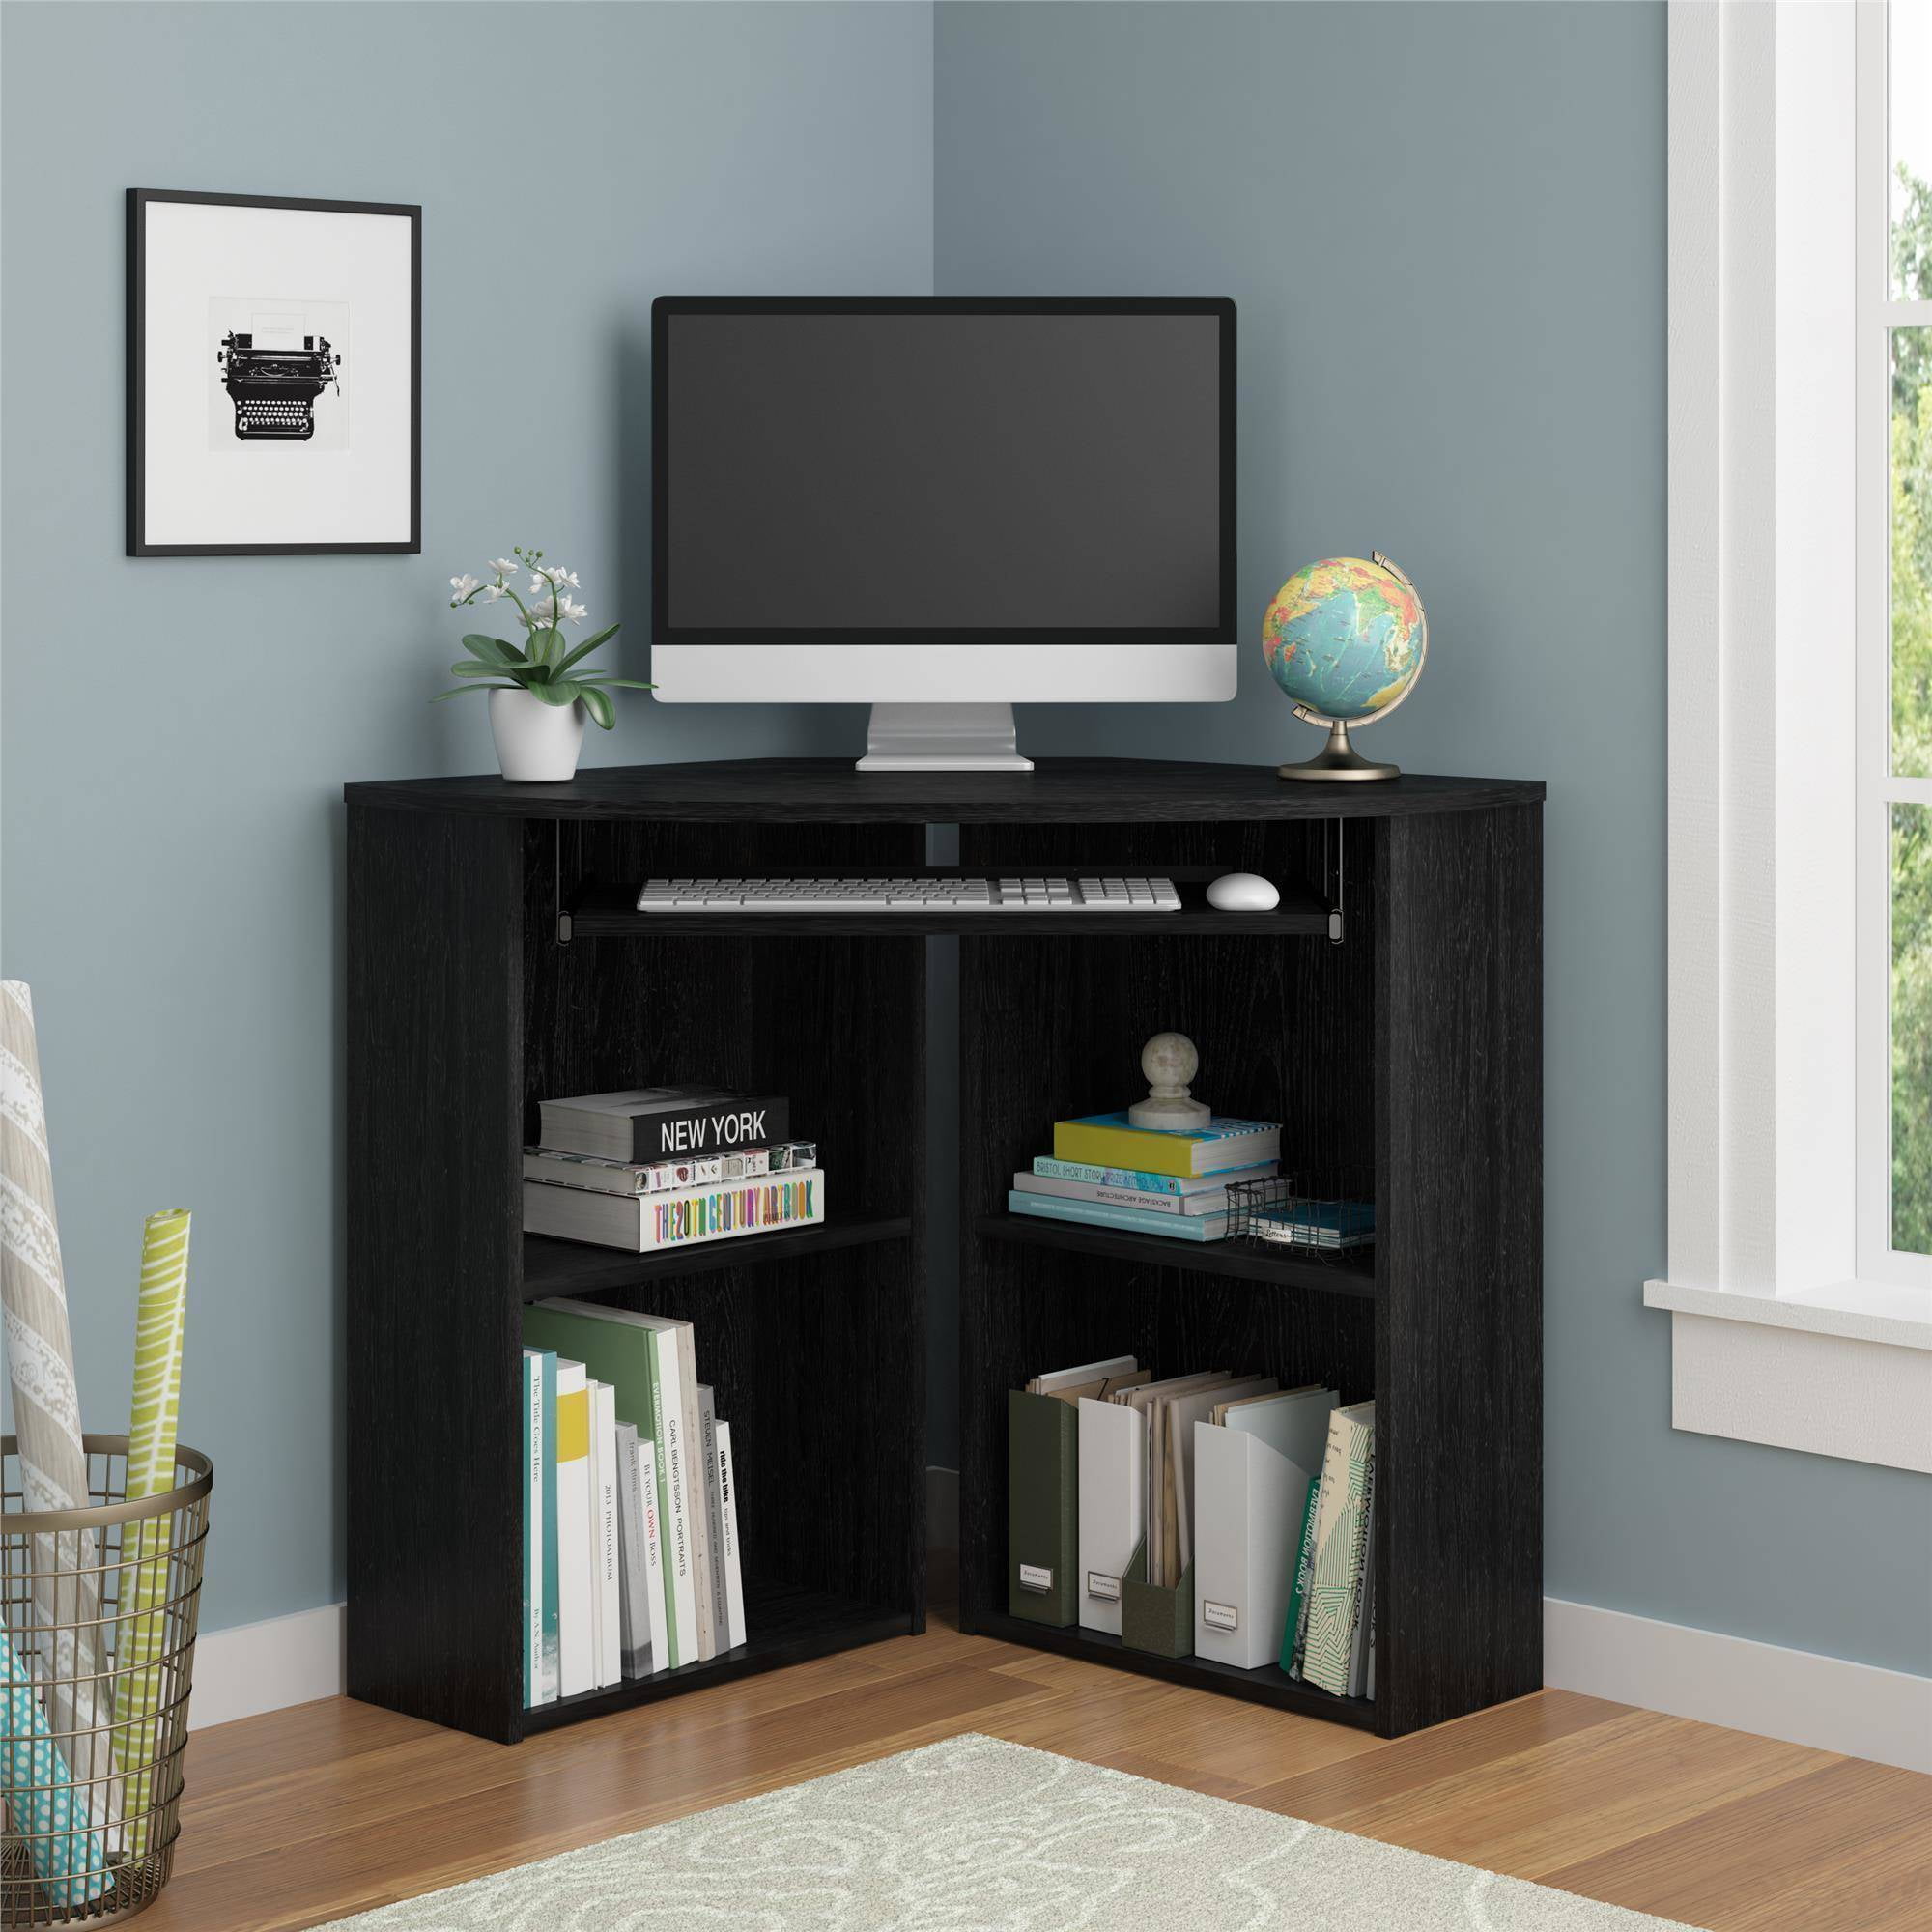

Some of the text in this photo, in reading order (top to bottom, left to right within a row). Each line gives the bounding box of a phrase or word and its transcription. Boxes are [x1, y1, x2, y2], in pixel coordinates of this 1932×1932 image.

[661, 1110, 767, 1152] NEW YORK
[1036, 1161, 1061, 1177] BRISTOL
[1063, 1165, 1083, 1179] SHORT
[709, 1185, 761, 1234] CENTURY
[1138, 1196, 1171, 1208] BACKSTAGE
[652, 1382, 663, 1444] EVERMOTION
[703, 1410, 712, 1447] STEVEN
[643, 1464, 651, 1478] BE
[656, 1447, 665, 1477] BOOK
[720, 1450, 728, 1468] ride
[668, 1420, 686, 1577] CARL BENGTSSON PORTRAITS
[722, 1484, 730, 1503] bike
[646, 1509, 656, 1539] OWN
